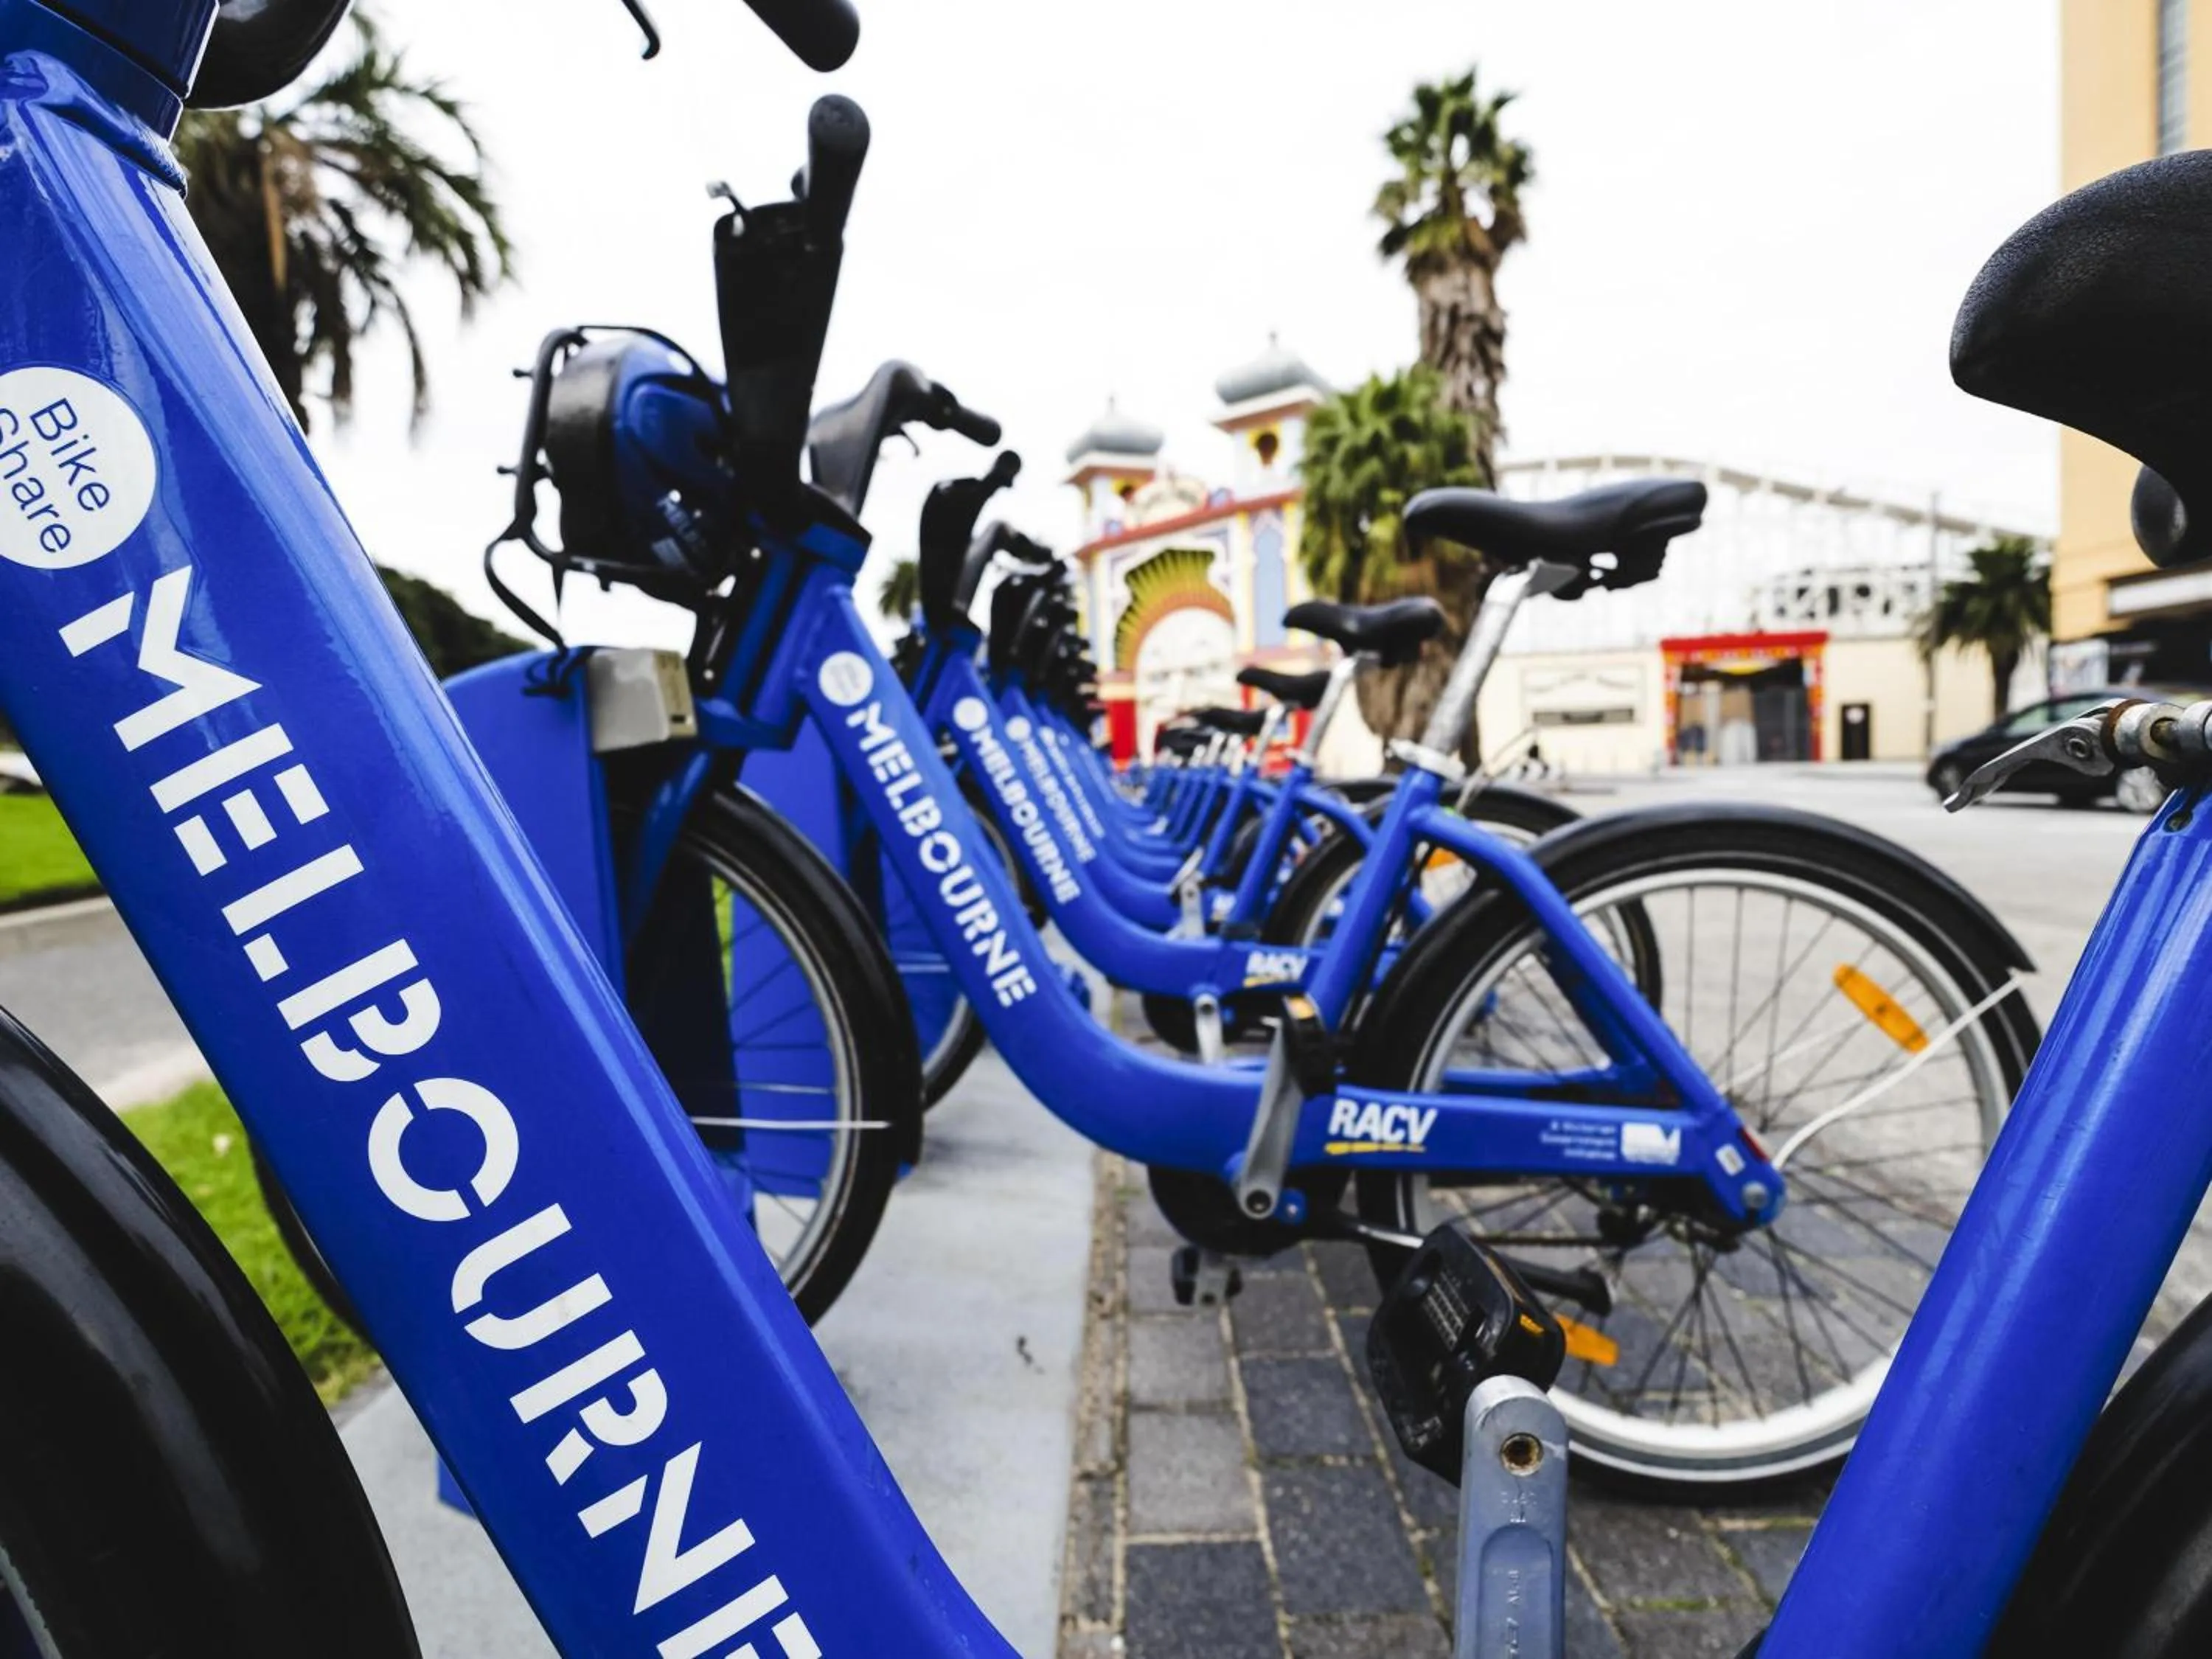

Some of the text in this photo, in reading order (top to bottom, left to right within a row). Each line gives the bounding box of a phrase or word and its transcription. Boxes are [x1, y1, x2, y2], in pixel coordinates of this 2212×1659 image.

[29, 397, 110, 512] Bike
[846, 700, 1037, 1006] MELBOURNE
[970, 725, 1081, 904] MELBOURNE
[59, 566, 822, 1659] MELBOURNE
[1328, 1099, 1437, 1146] RACV
